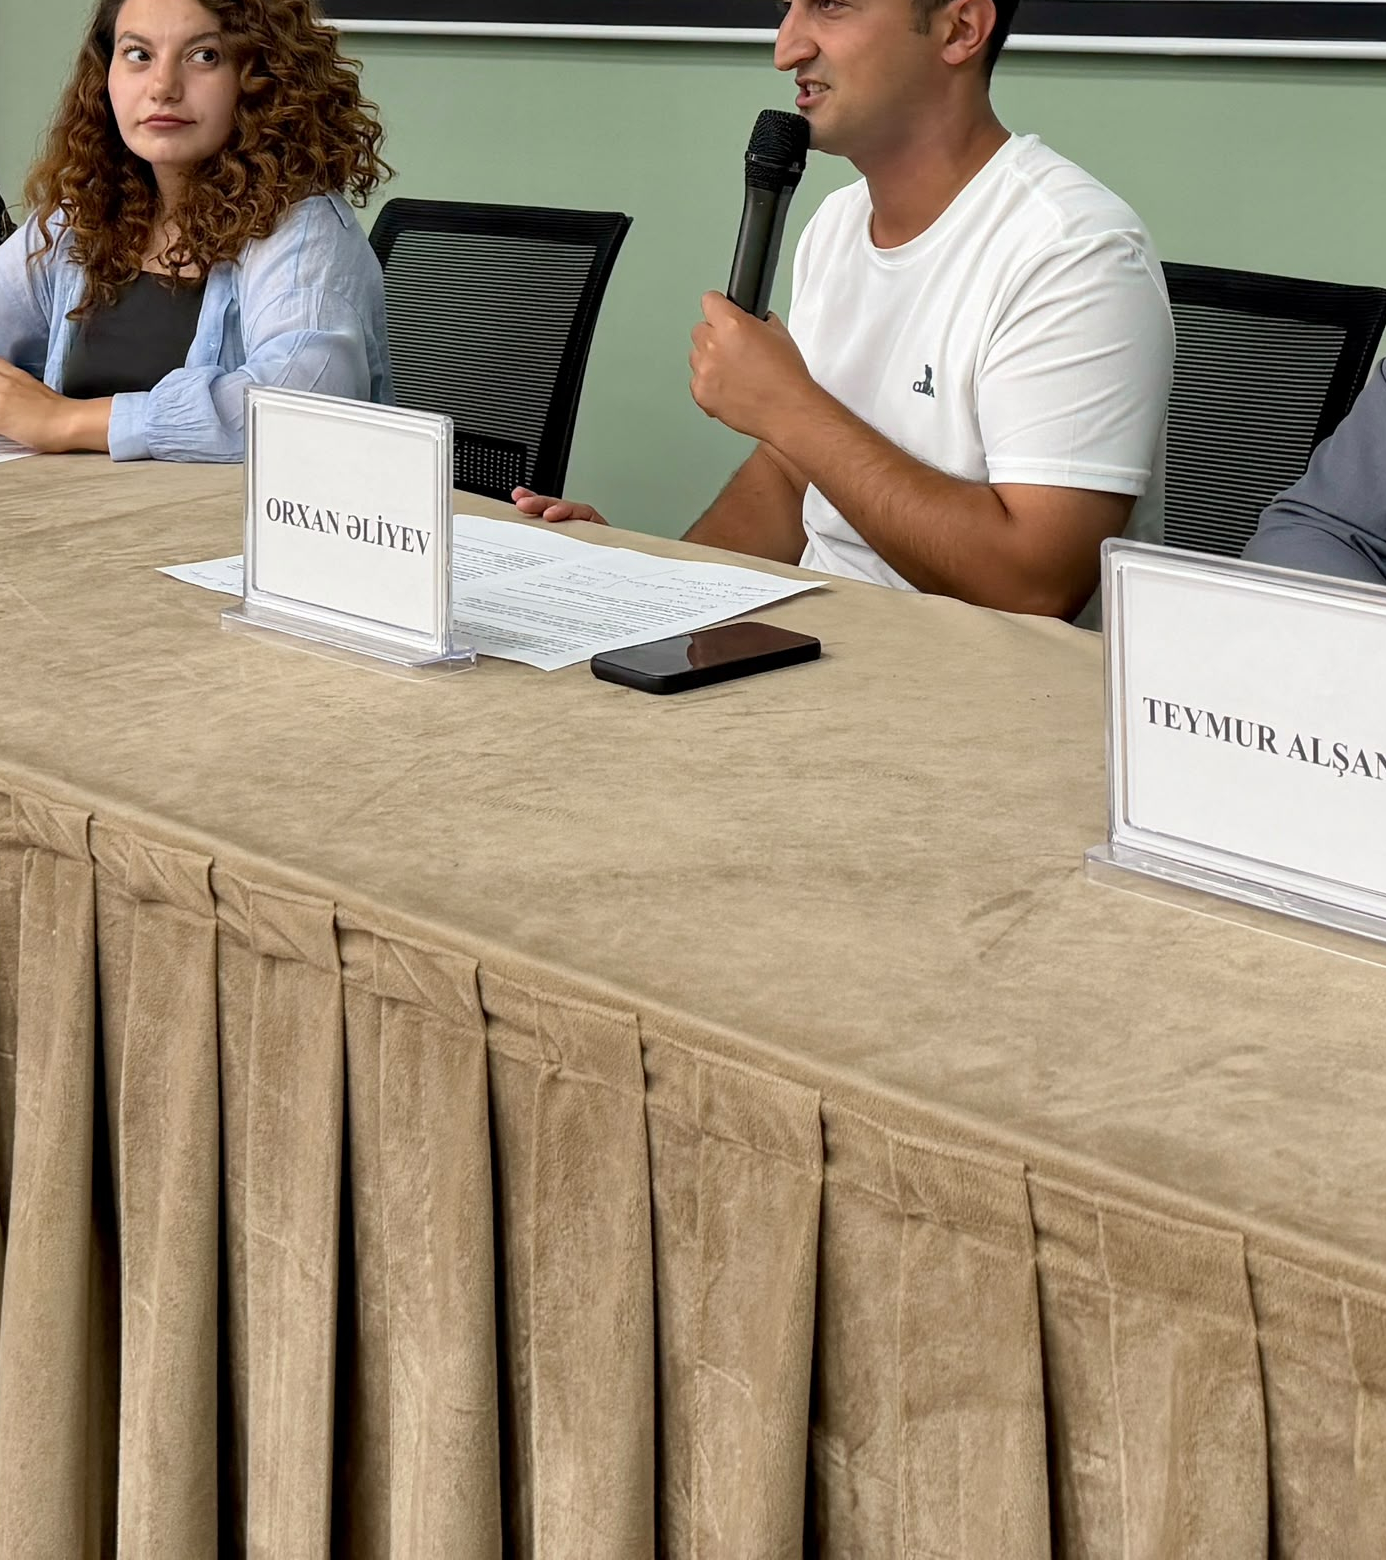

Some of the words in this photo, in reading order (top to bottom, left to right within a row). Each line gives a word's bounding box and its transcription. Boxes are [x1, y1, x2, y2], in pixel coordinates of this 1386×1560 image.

[266, 497, 340, 536] ORXAN
[346, 514, 432, 556] ƏLİYEV
[1142, 696, 1279, 755] TEYMUR
